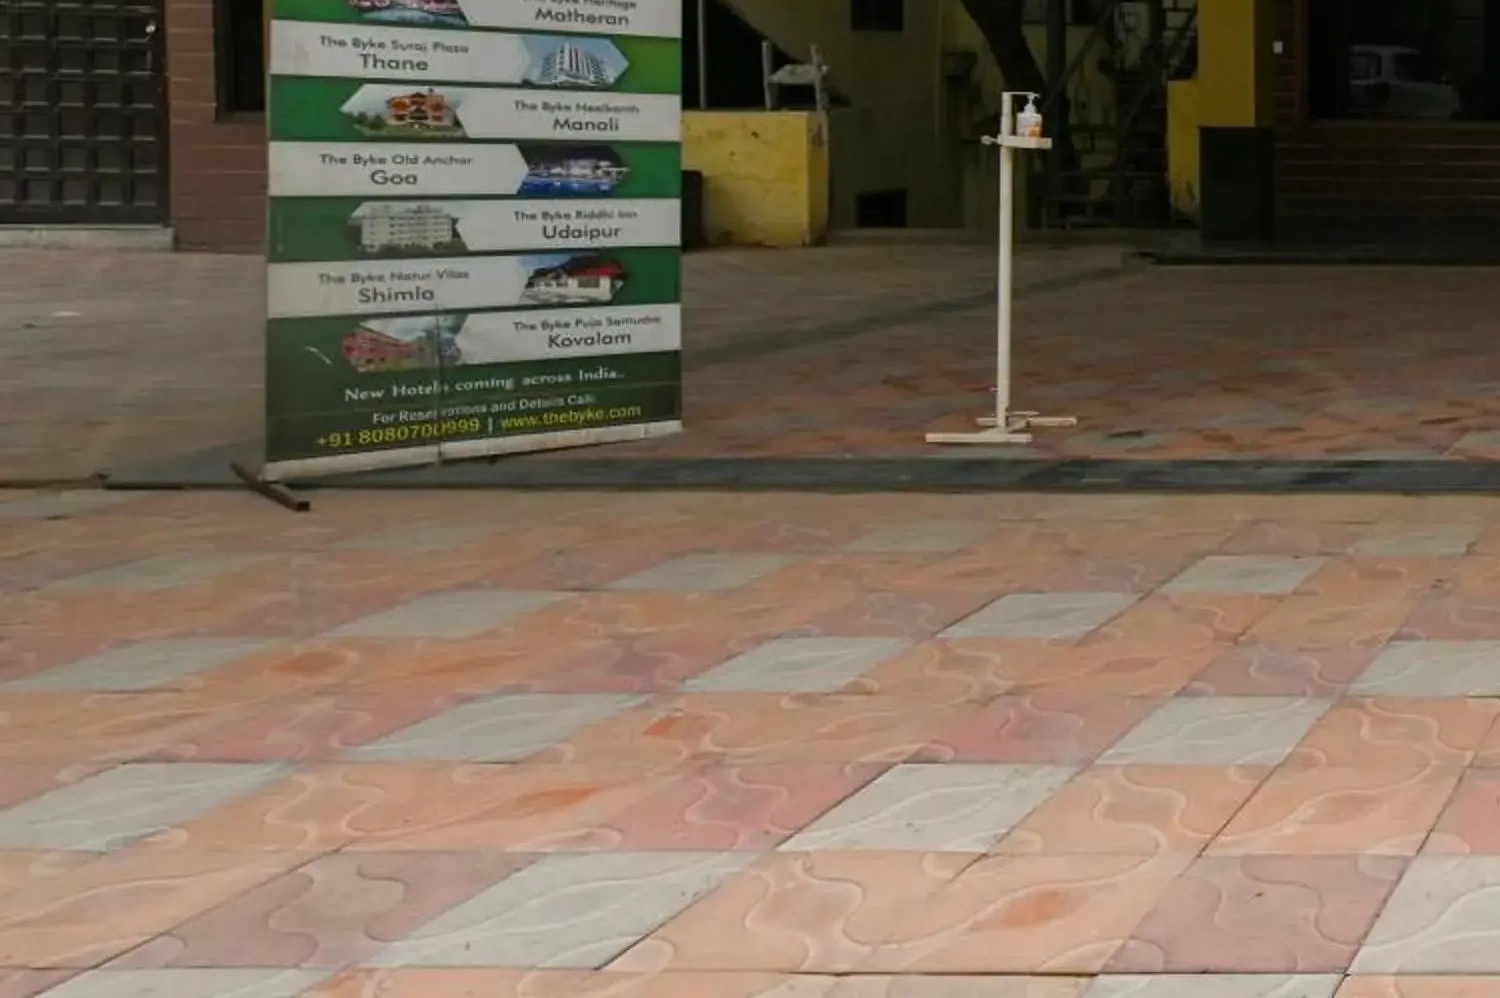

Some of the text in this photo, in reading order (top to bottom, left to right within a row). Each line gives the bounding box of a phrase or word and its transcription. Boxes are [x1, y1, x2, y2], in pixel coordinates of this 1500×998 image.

[535, 8, 629, 27] Matheran
[320, 35, 347, 48] The
[351, 37, 386, 51] Byke
[391, 39, 428, 53] Suraj
[360, 53, 429, 71] Thane
[514, 100, 538, 111] The
[541, 101, 571, 114] Byke
[553, 117, 619, 131] Manali
[319, 153, 472, 167] The Byke Old Anchor
[370, 169, 417, 185] Goa
[513, 210, 537, 221] The
[541, 211, 571, 222] Byke
[542, 224, 622, 241] Udaipur
[318, 273, 346, 285] The
[351, 272, 386, 285] Byke
[358, 286, 435, 303] Shimla
[512, 320, 537, 332] The
[541, 319, 570, 332] Byke
[548, 331, 631, 349] Kovalam
[344, 387, 385, 402] New
[455, 376, 515, 392] coming
[522, 373, 572, 387] across
[373, 412, 395, 425] For
[400, 404, 487, 422] Reserations
[490, 400, 516, 413] and
[316, 431, 353, 448] +91
[358, 417, 481, 445] 8080700999
[500, 404, 642, 431] www.thebyke.com
